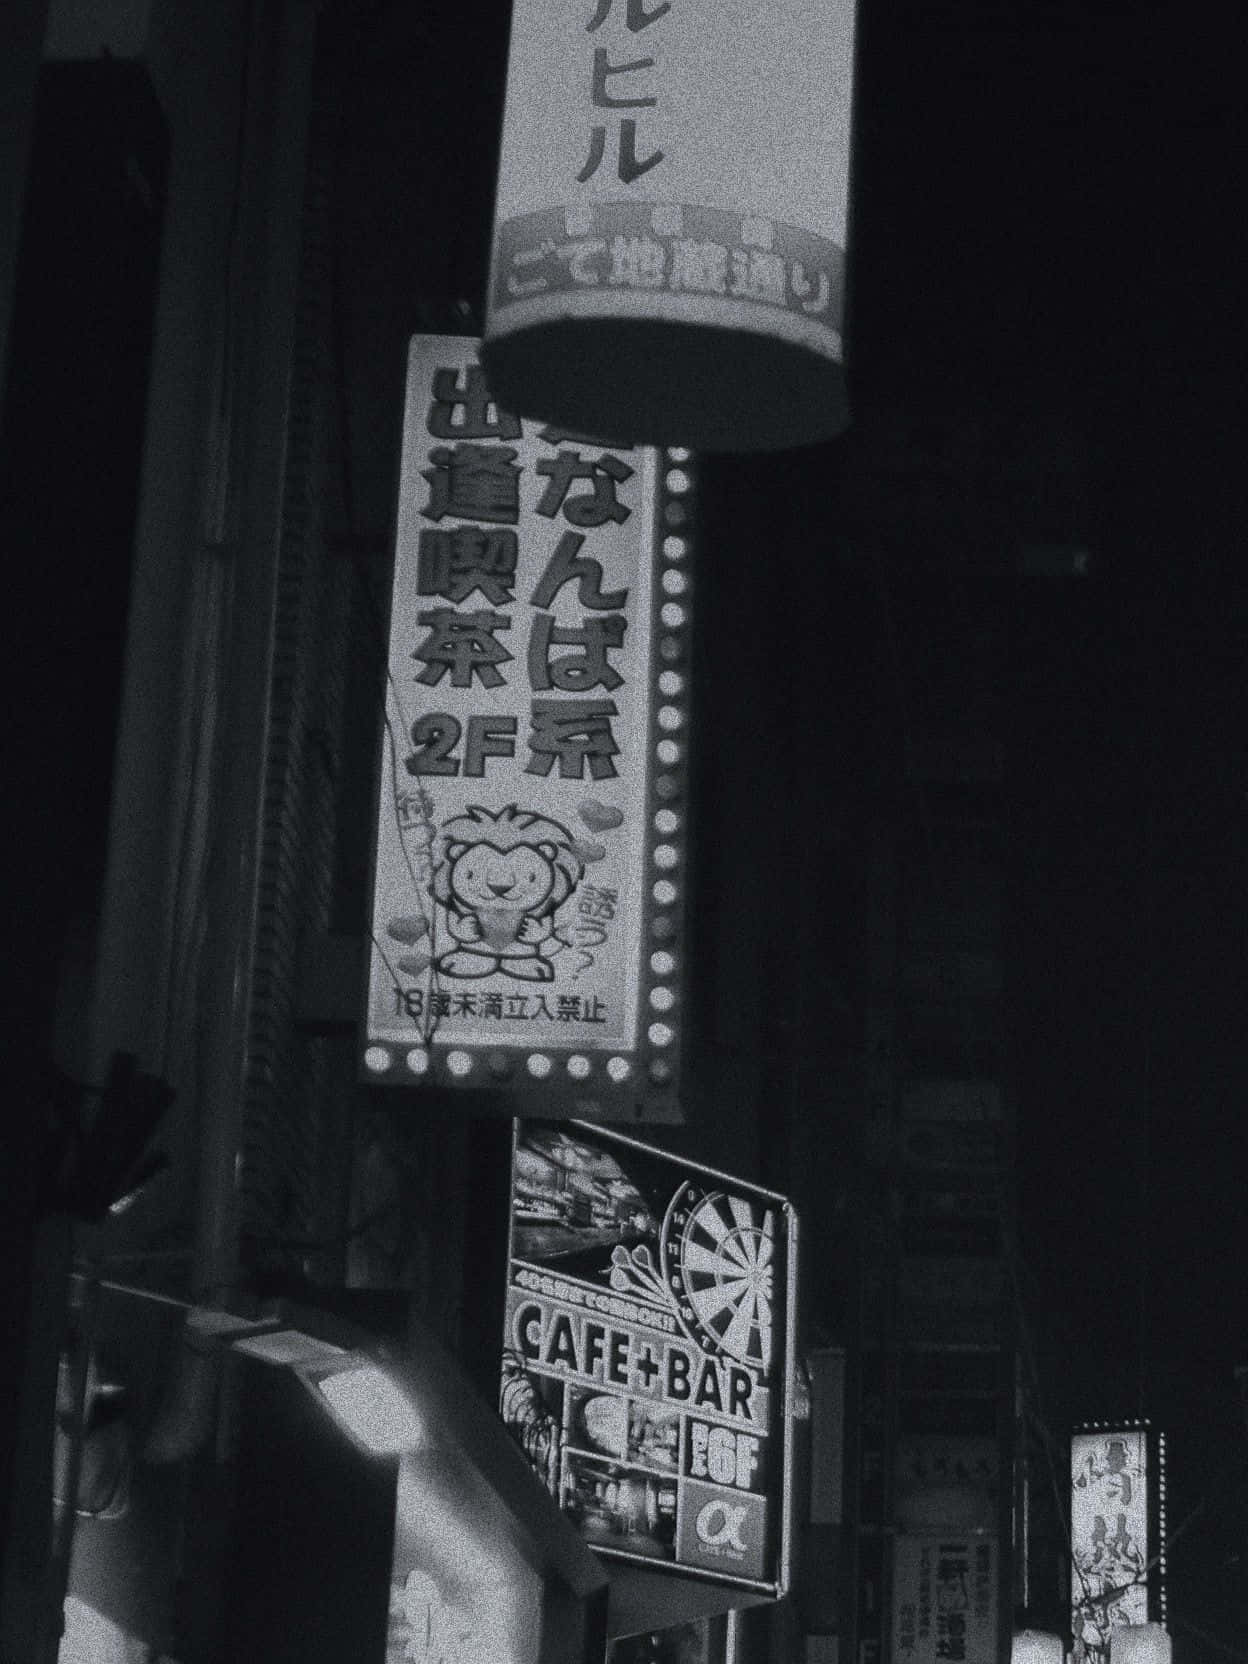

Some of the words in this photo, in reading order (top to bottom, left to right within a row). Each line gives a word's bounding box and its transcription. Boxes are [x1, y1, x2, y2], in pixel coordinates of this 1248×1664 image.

[525, 425, 635, 780] なんぱ系
[406, 712, 518, 778] 2F
